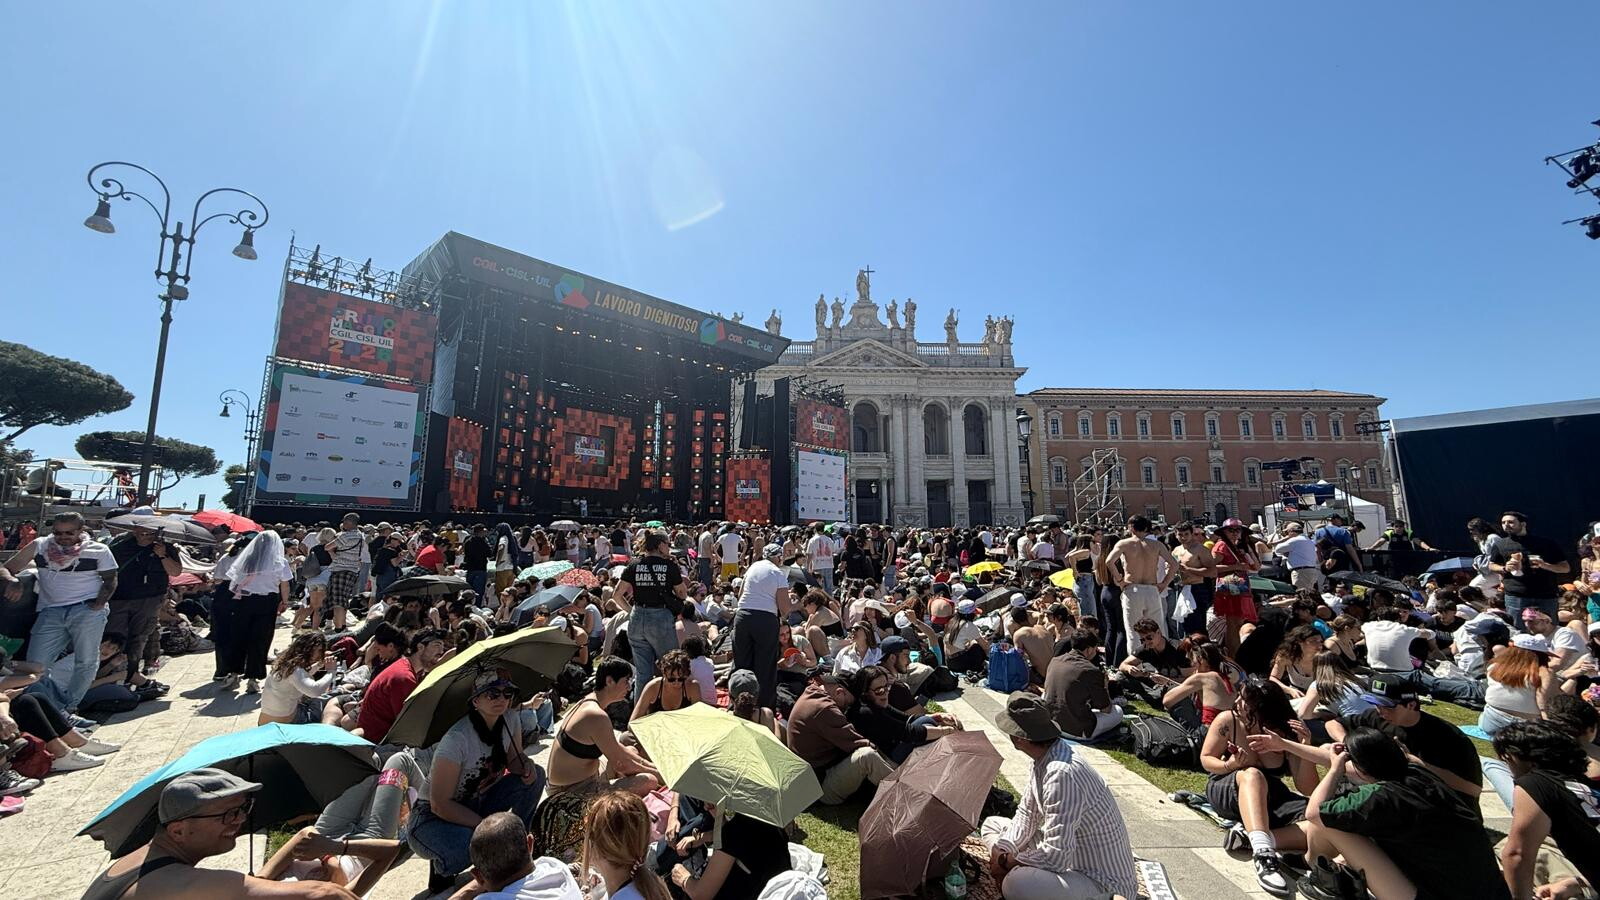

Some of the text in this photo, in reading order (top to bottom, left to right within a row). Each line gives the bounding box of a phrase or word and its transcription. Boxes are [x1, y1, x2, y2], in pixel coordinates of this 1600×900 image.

[473, 256, 551, 288] CGIL CISL UIL
[594, 291, 699, 334] LAVORO DIGNITOSO
[330, 328, 393, 347] CGIL CISL UIL
[635, 564, 668, 572] BREKING
[635, 573, 666, 581] BARRRS
